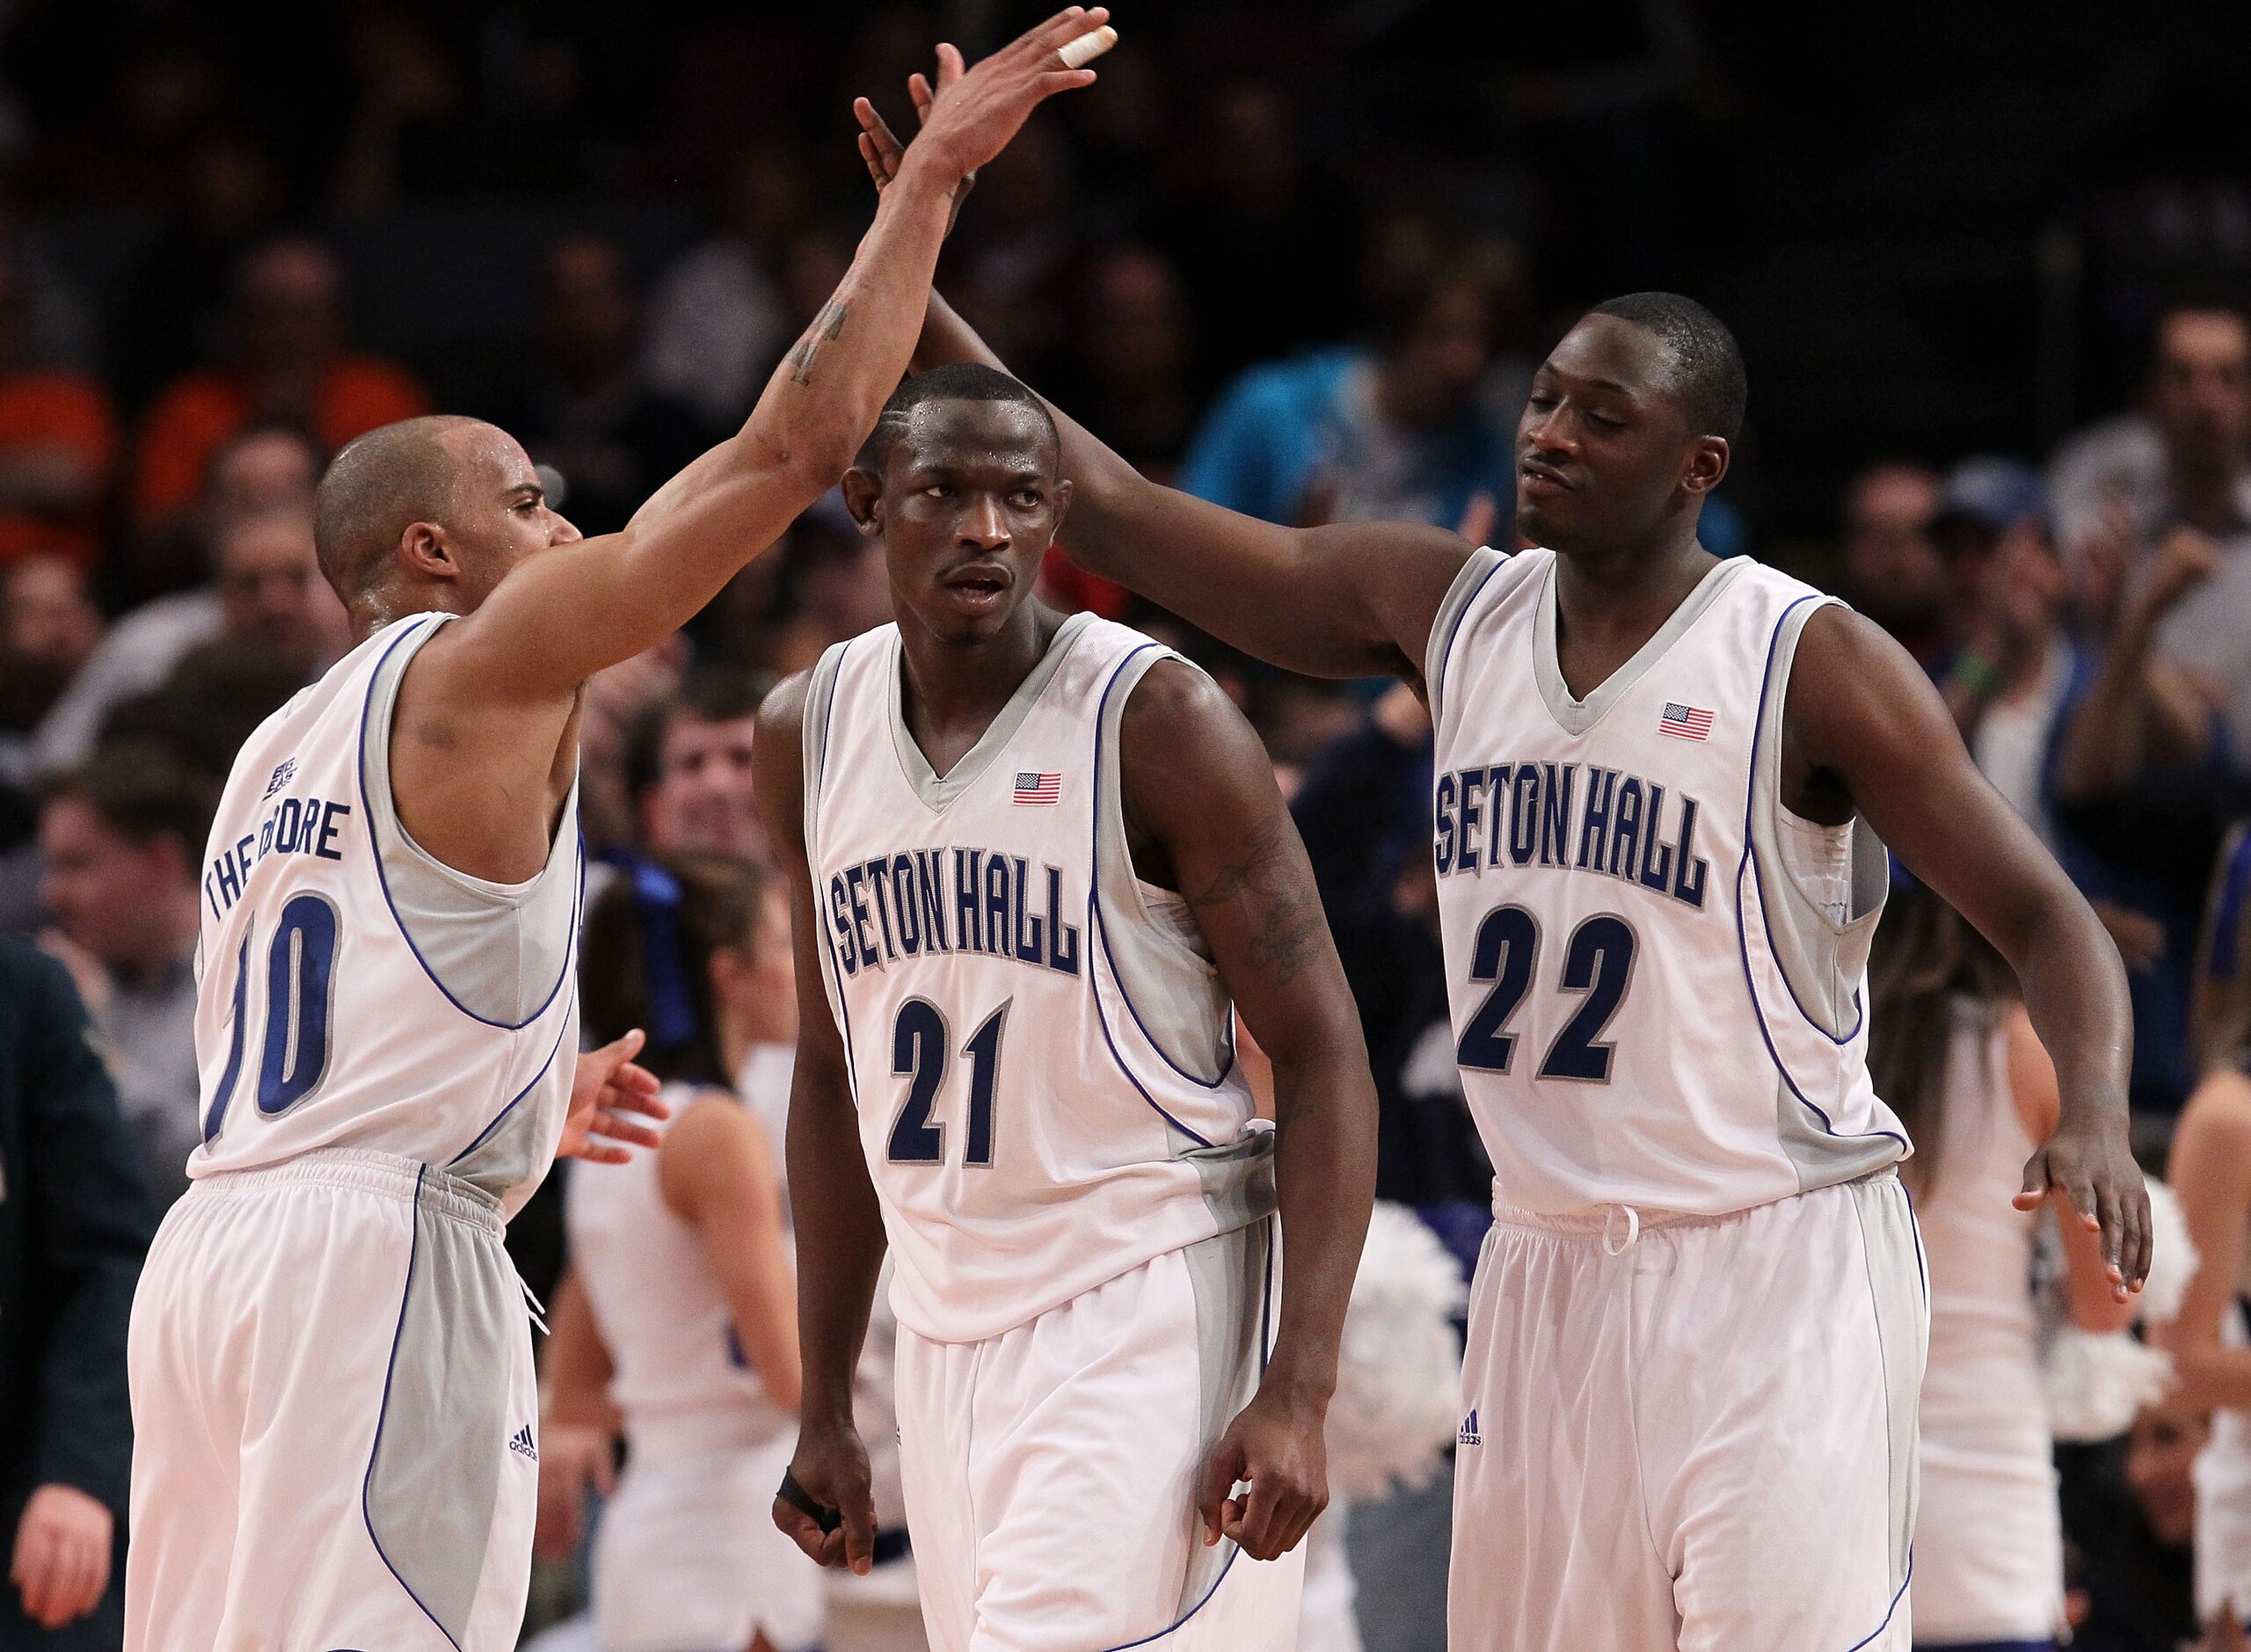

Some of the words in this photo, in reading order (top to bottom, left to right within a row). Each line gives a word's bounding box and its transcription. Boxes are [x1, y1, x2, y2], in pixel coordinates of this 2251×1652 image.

[205, 798, 351, 923] THEDORE
[1435, 760, 1580, 879] SETON
[1574, 765, 1710, 912] HALL
[829, 847, 953, 979] SETON
[951, 847, 1082, 979] HALL
[203, 889, 342, 1155] 10
[1455, 903, 1640, 1085] 22
[885, 993, 1014, 1169] 21
[1459, 1432, 1482, 1446] didas
